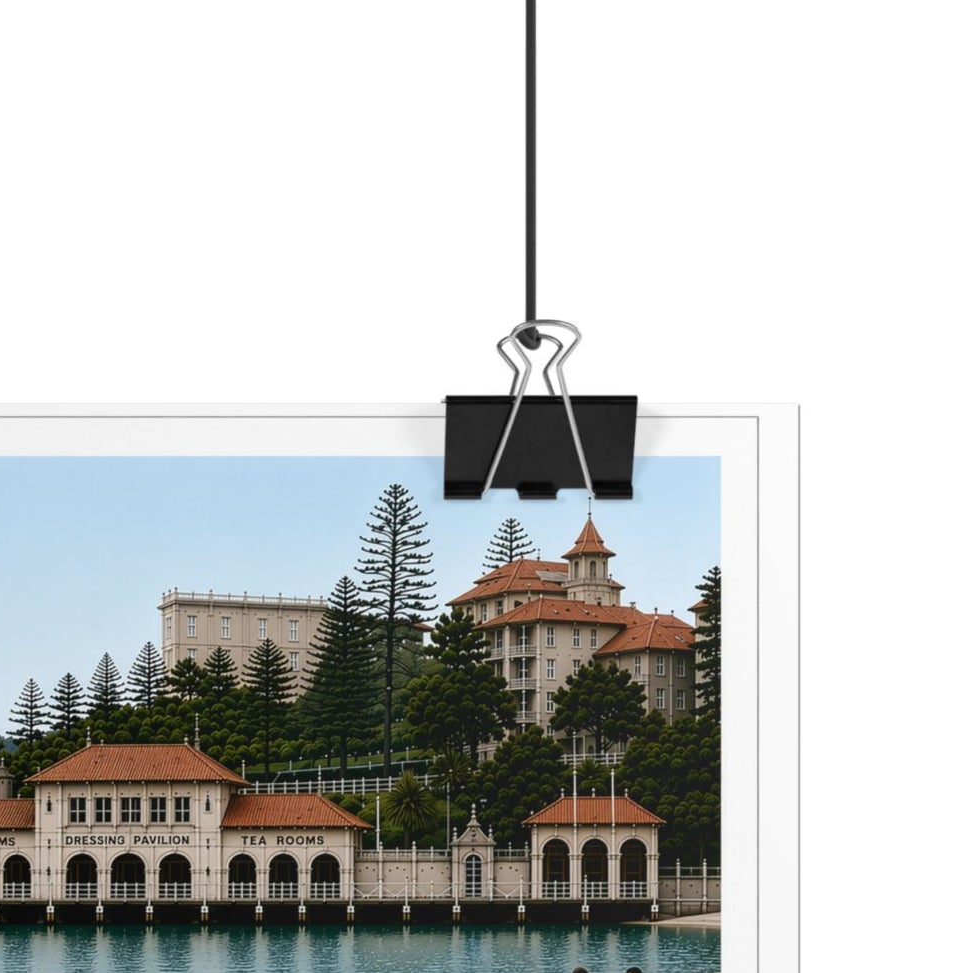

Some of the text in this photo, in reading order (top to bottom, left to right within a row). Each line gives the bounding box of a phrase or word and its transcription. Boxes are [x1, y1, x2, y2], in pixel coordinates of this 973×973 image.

[65, 835, 190, 846] DRESSING PAVILION
[240, 836, 325, 846] TEA ROOMS
